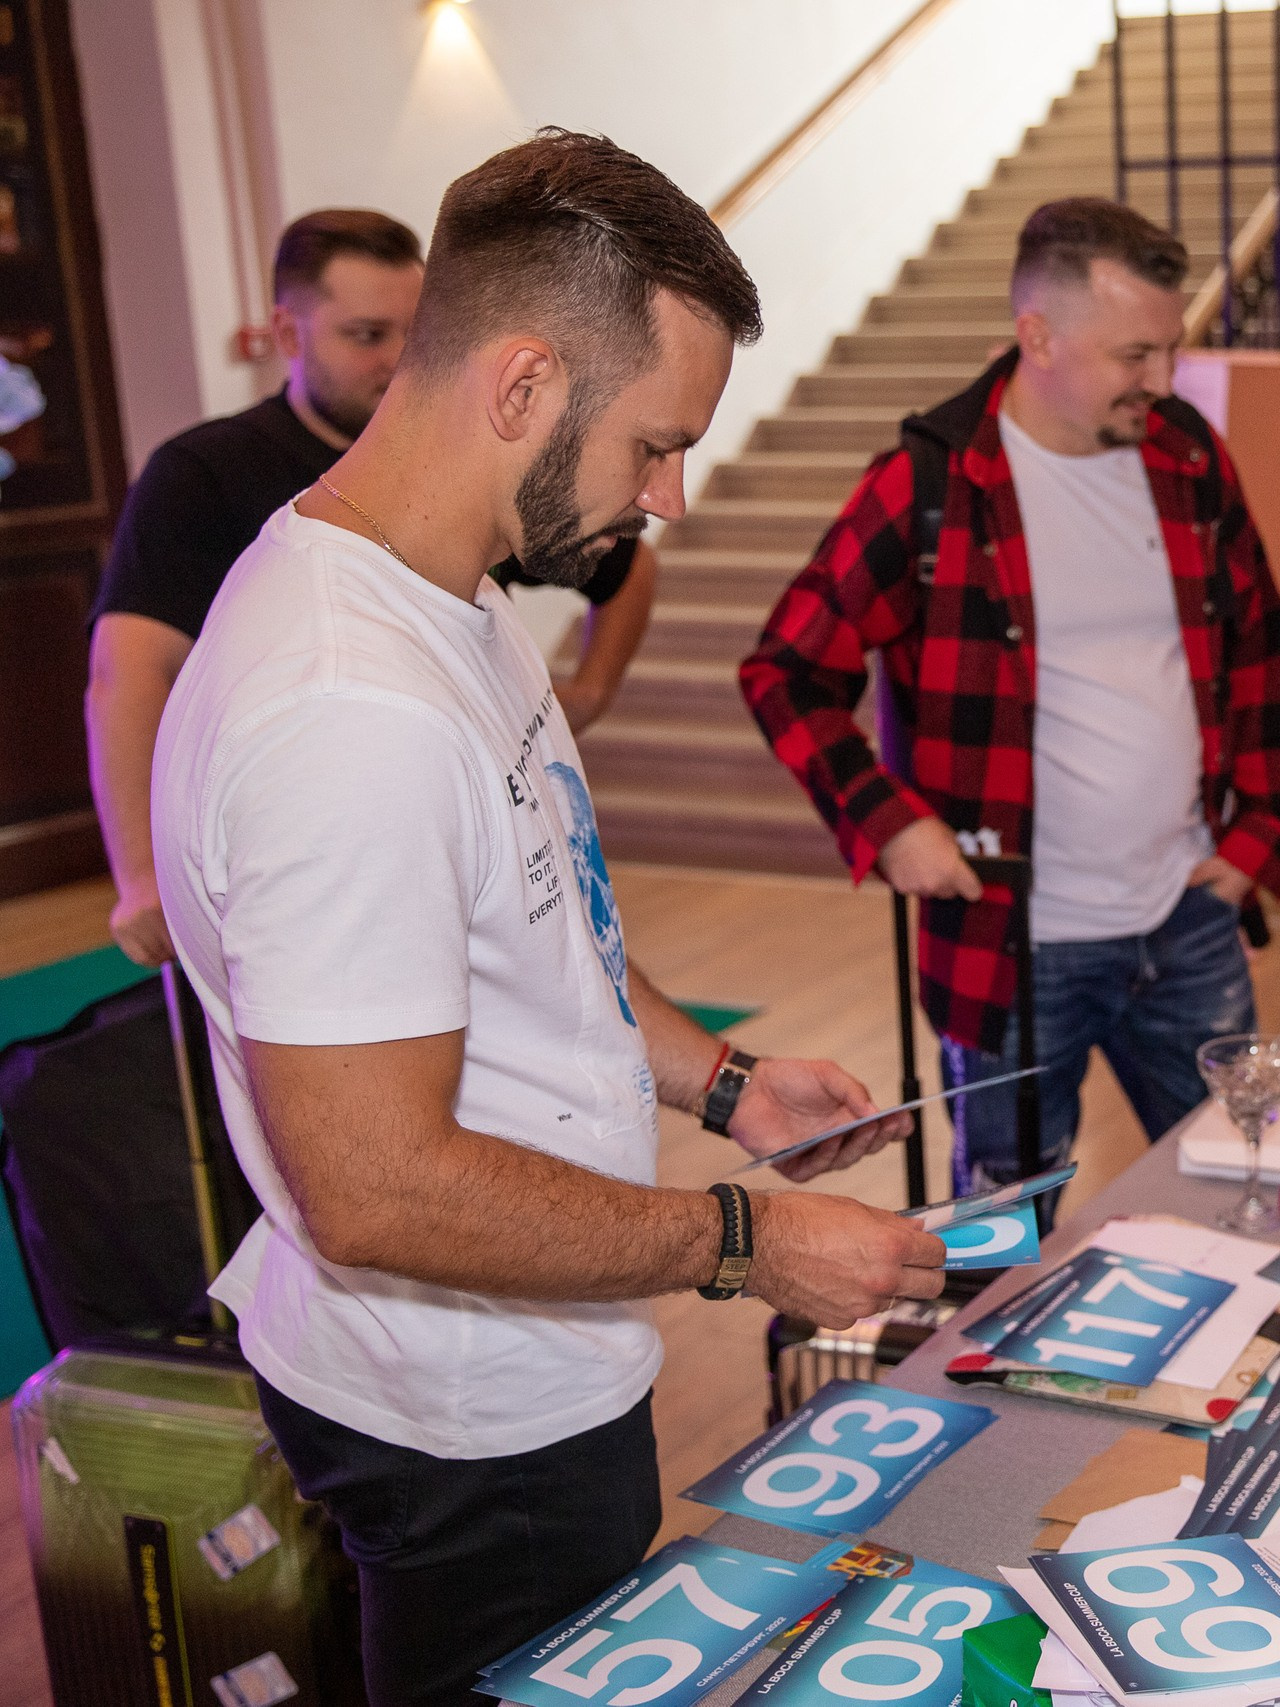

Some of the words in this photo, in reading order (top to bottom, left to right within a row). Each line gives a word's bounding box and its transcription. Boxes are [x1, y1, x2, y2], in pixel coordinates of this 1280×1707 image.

[529, 870, 542, 885] TO
[547, 876, 559, 893] LIF
[529, 891, 564, 925] EVERYT
[1033, 1267, 1190, 1367] 117
[742, 1399, 945, 1516] 93
[1063, 1582, 1081, 1597] CUP
[532, 1648, 550, 1659] LA
[546, 1627, 580, 1648] BOCA
[575, 1593, 622, 1627] SUMMER
[618, 1578, 640, 1595] CUP
[1073, 1596, 1103, 1627] SUMMER
[529, 1562, 761, 1707] 57
[1095, 1626, 1118, 1647] BOCA
[758, 1682, 775, 1695] LA
[769, 1658, 797, 1683] BOCA
[791, 1626, 827, 1660] SUMMER
[823, 1608, 843, 1626] CUP
[1109, 1647, 1125, 1657] LA
